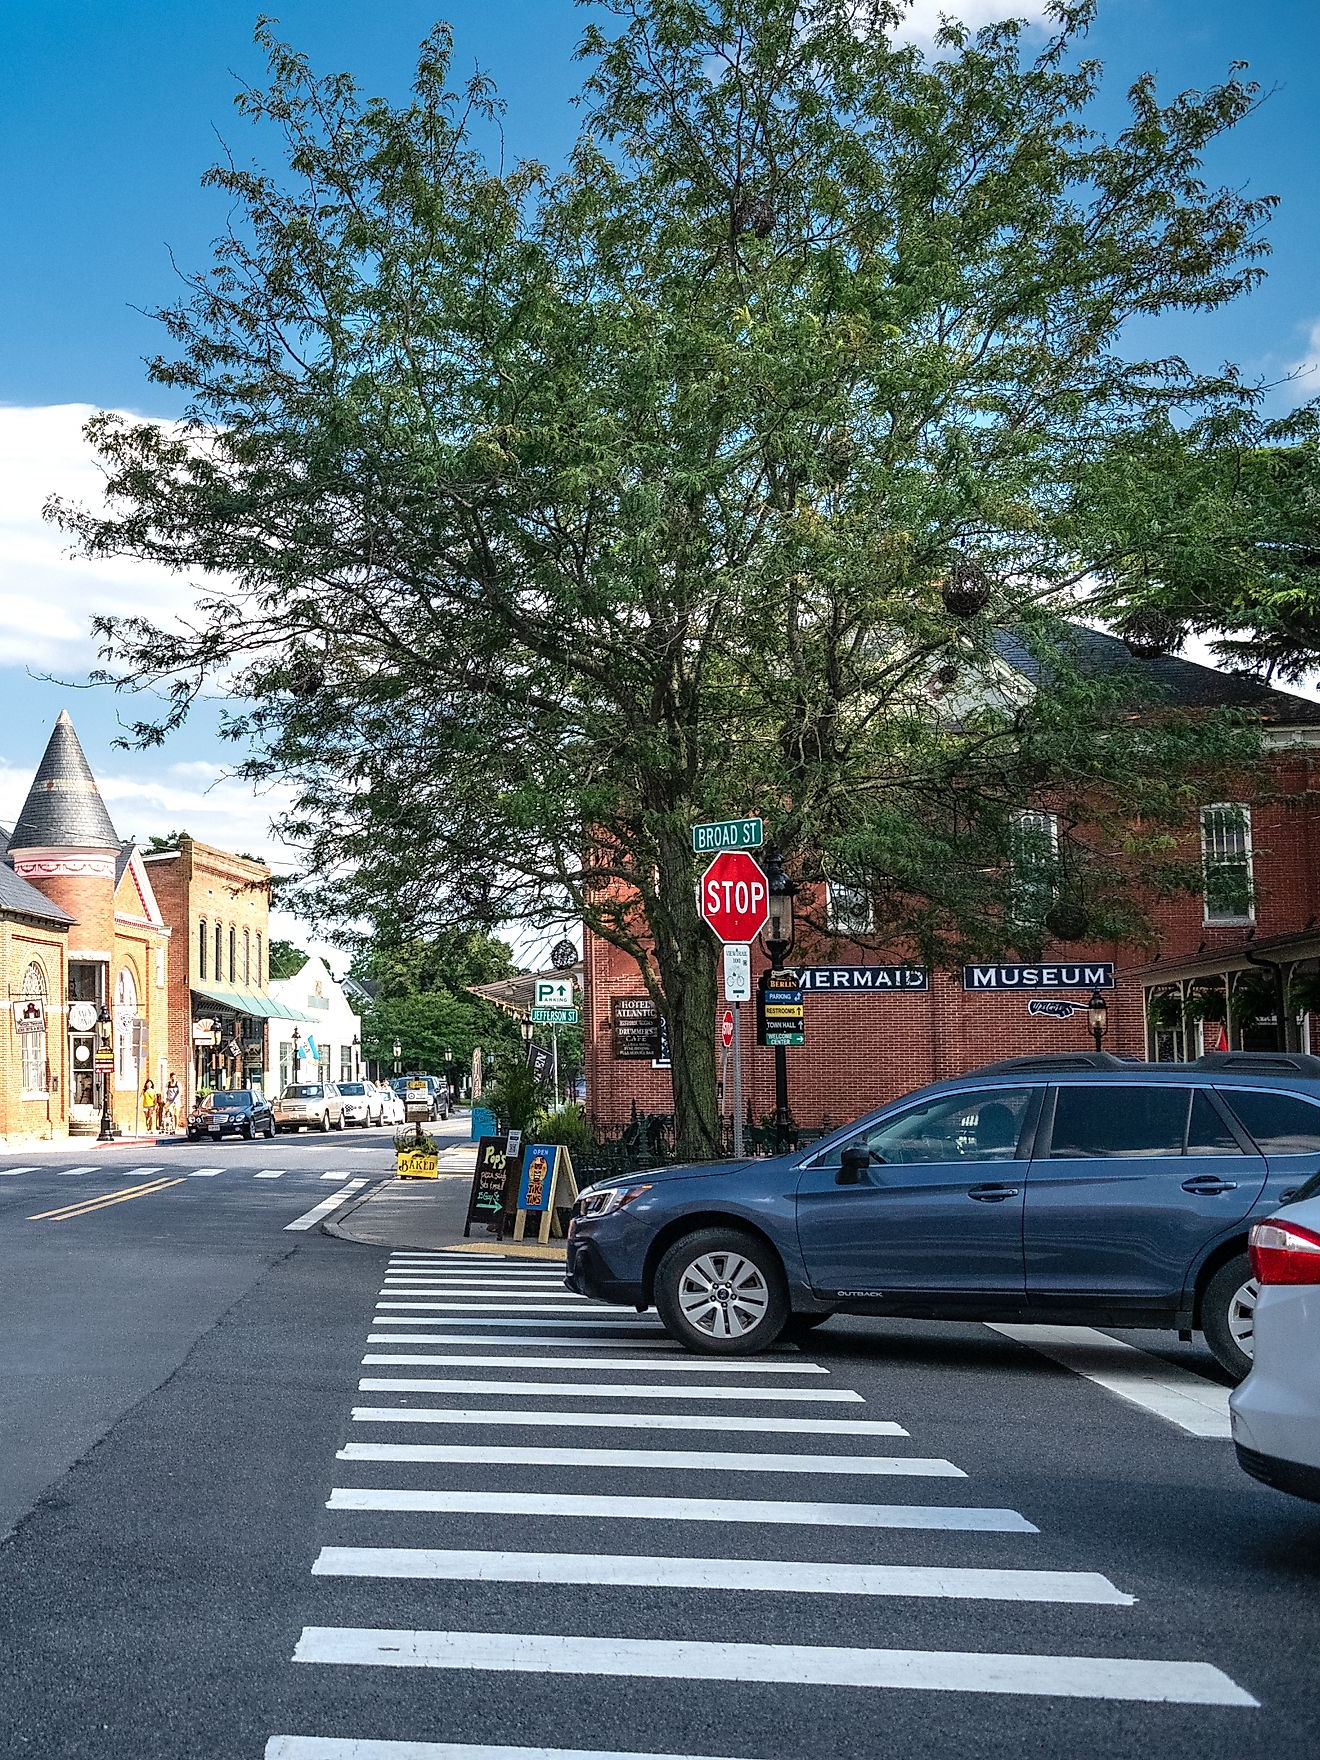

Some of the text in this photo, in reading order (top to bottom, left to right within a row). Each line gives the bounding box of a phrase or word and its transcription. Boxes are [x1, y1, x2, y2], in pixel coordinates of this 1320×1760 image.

[698, 822, 757, 848] BROAD ST
[707, 880, 764, 914] STOP
[770, 980, 797, 988] BERLIN
[793, 970, 923, 988] MERMAID
[972, 968, 1105, 987] MUSEUM
[621, 1000, 651, 1009] HOTEL
[533, 1011, 576, 1021] JEFFERSON ST
[617, 1009, 657, 1017] ATLANTIC
[722, 1022, 733, 1035] STOP
[483, 1145, 507, 1170] Pop's
[398, 1159, 435, 1172] BAKED
